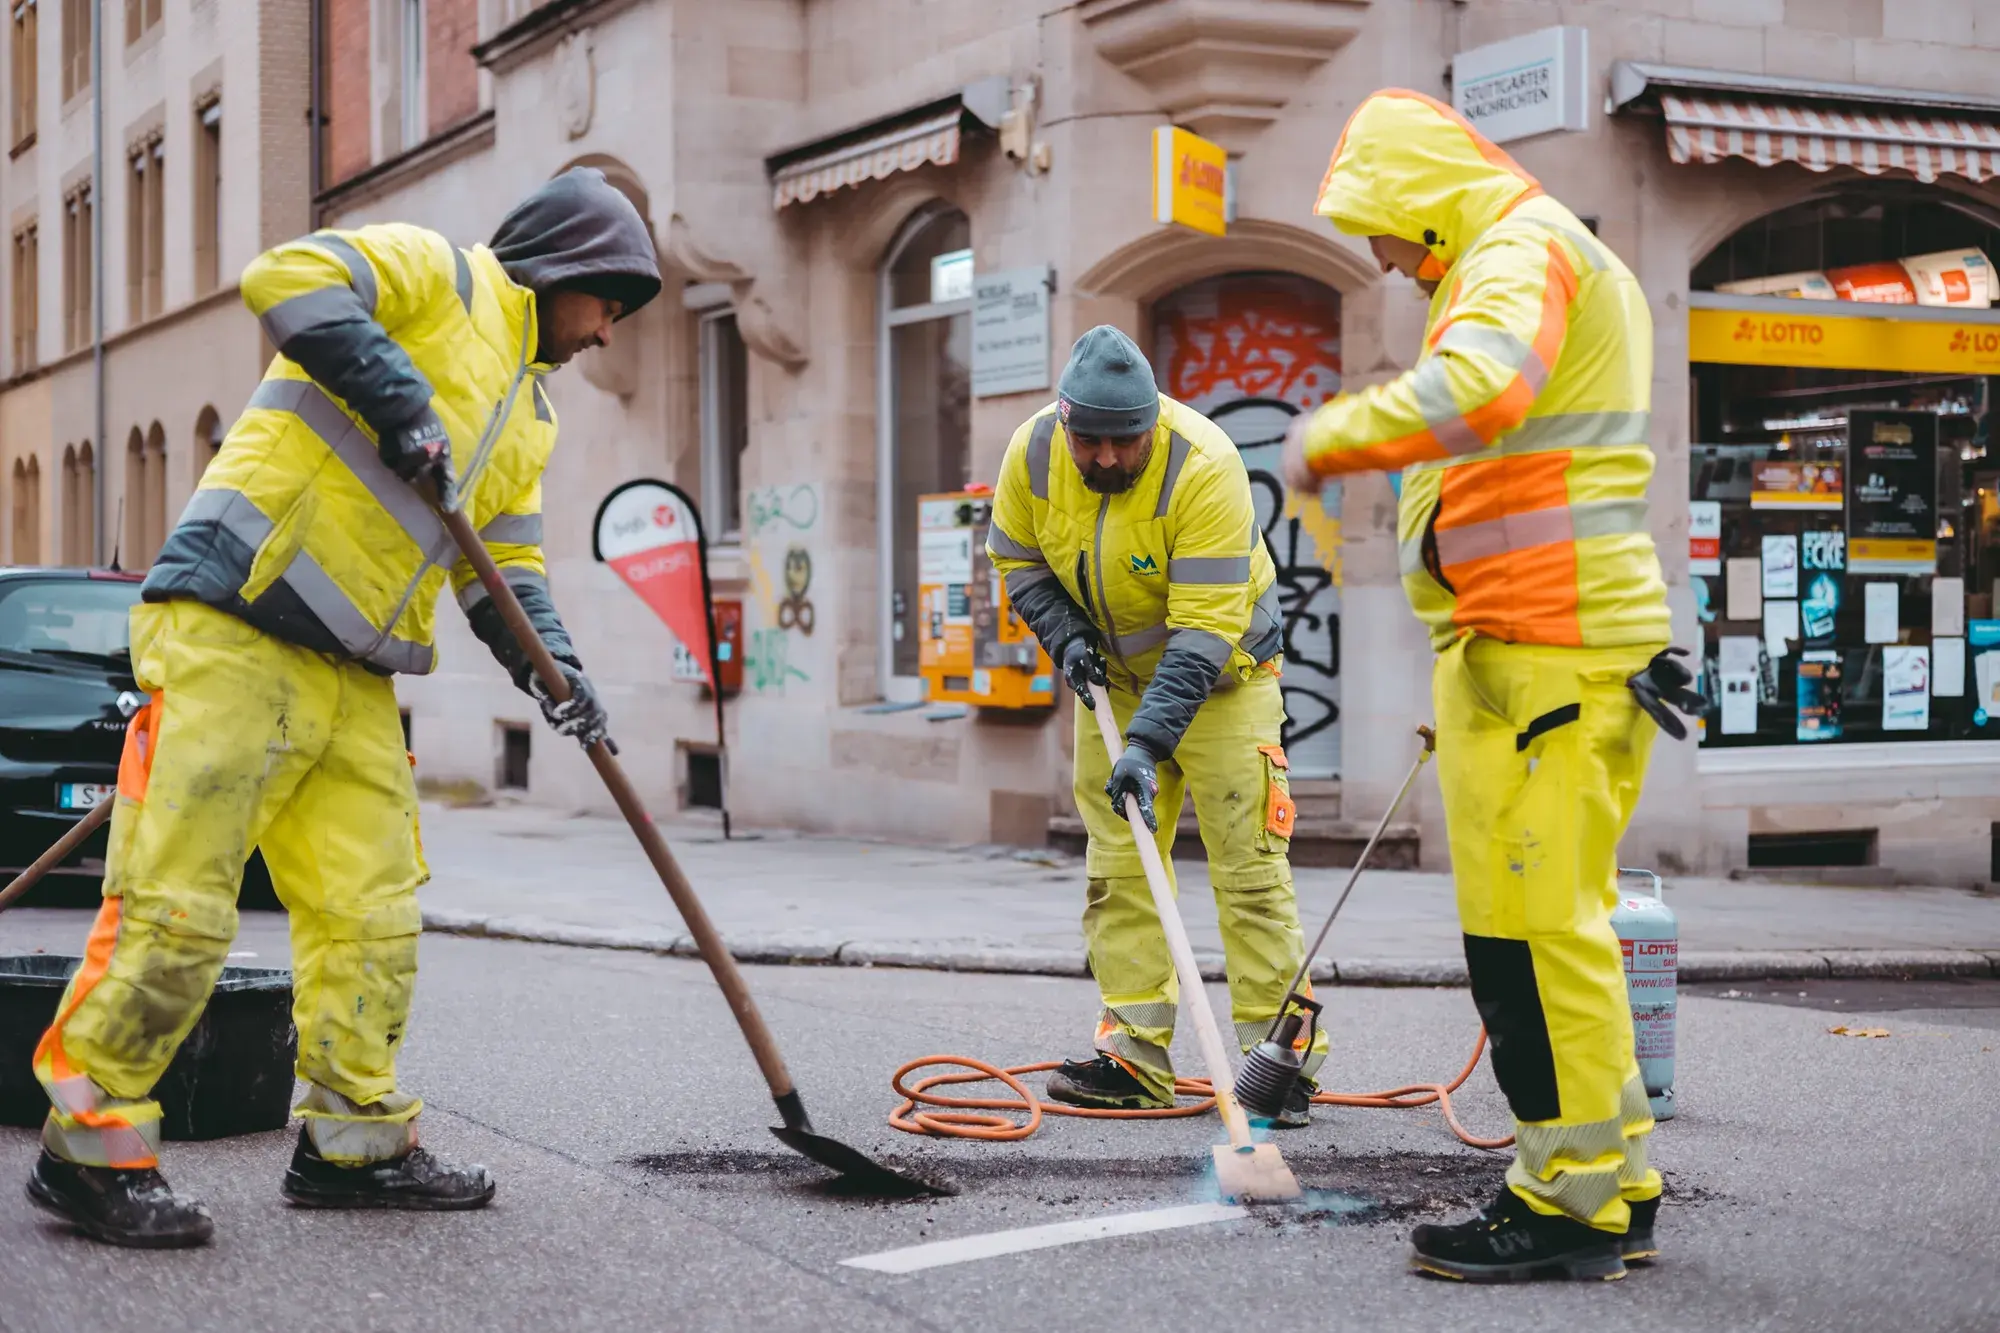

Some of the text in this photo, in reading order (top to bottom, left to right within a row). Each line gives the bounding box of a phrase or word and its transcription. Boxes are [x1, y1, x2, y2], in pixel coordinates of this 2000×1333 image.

[1463, 67, 1549, 100] STUTTGARTER
[1761, 323, 1824, 345] LOTTO
[1974, 332, 2000, 352] LO
